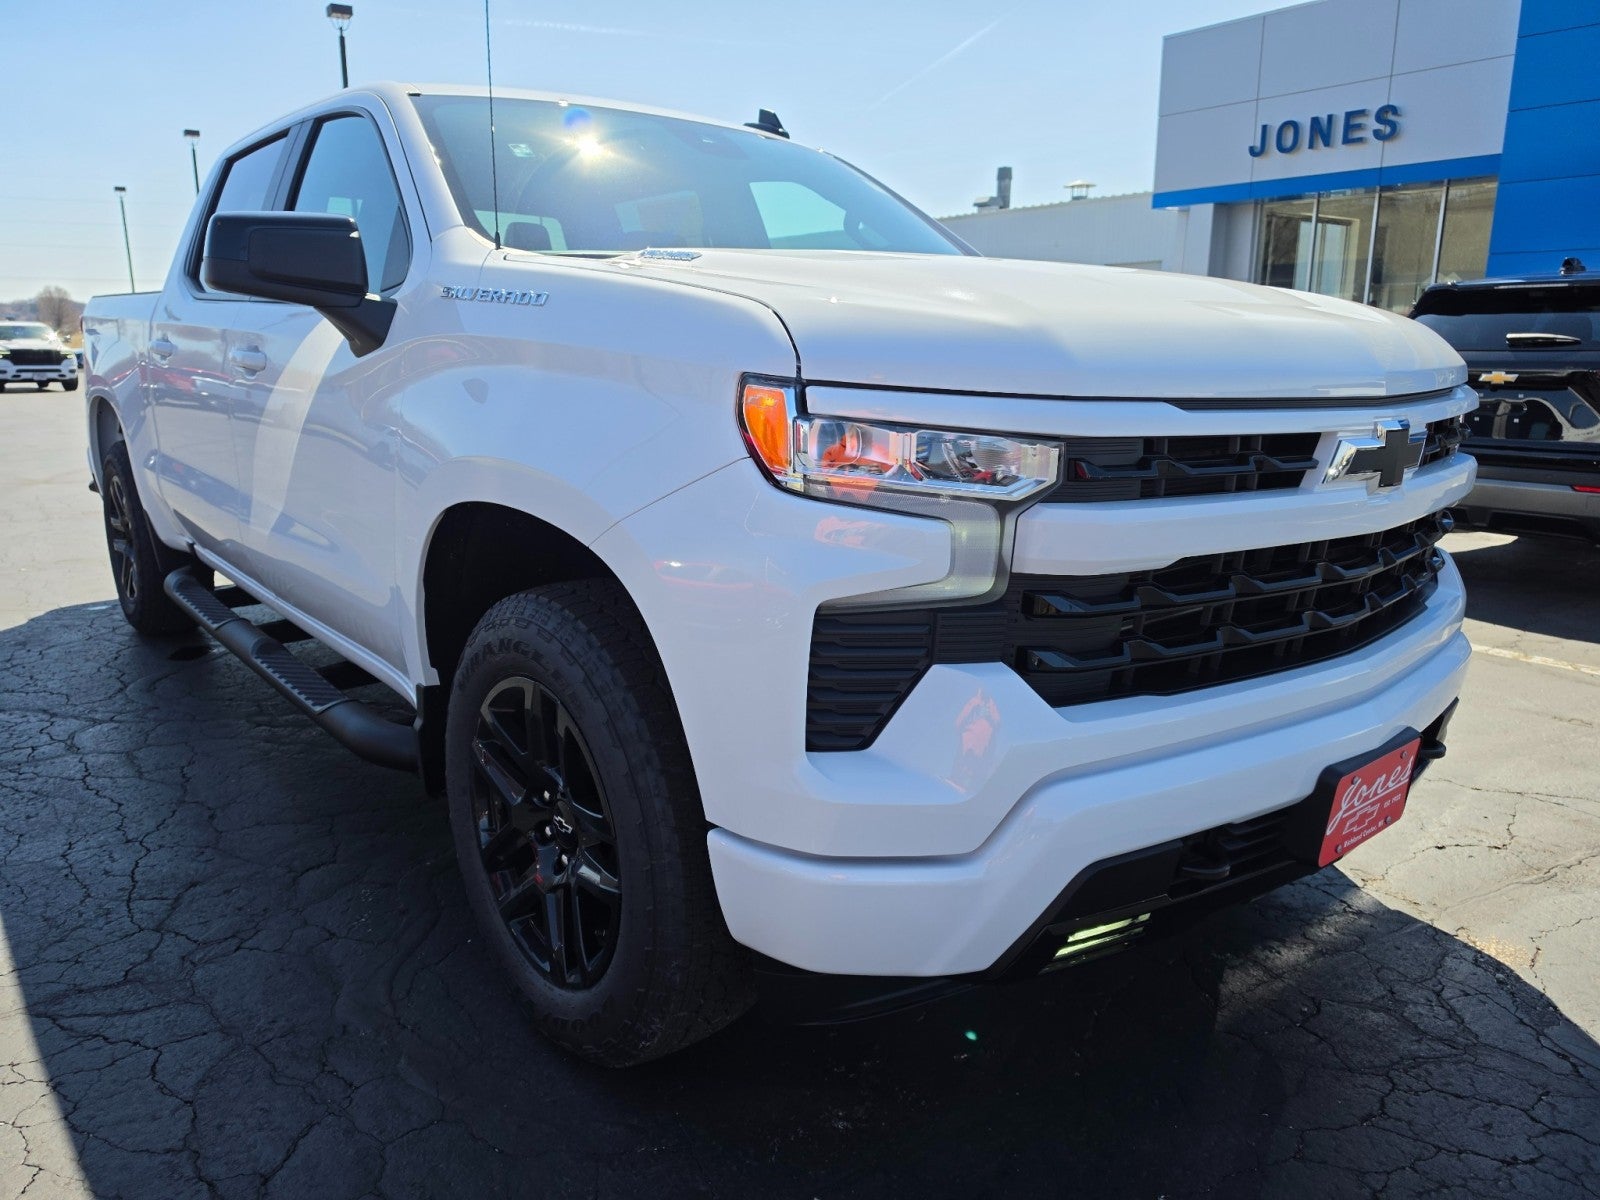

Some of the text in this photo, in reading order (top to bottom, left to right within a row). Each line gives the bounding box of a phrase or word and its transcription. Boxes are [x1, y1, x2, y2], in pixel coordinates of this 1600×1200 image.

[1248, 104, 1401, 158] JONES
[441, 286, 549, 306] SILVERADO
[1325, 755, 1414, 836] Jones
